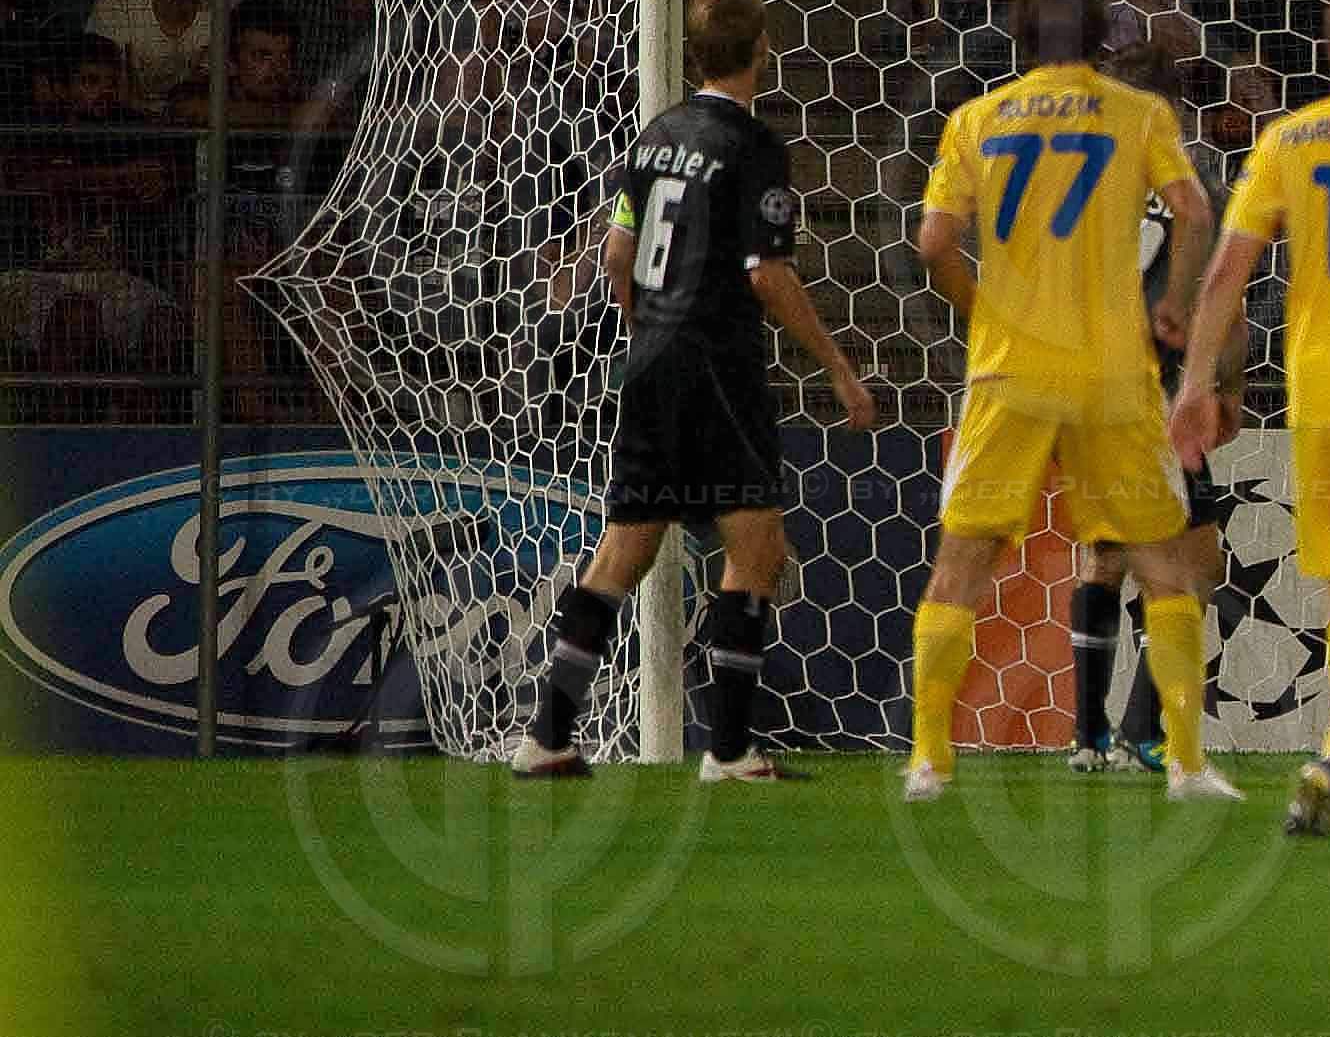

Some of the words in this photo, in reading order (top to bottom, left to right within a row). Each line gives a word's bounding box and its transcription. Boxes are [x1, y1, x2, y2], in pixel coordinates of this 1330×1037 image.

[634, 142, 726, 183] weber
[982, 133, 1116, 244] 77
[633, 175, 688, 293] 6
[122, 499, 580, 687] Ford
